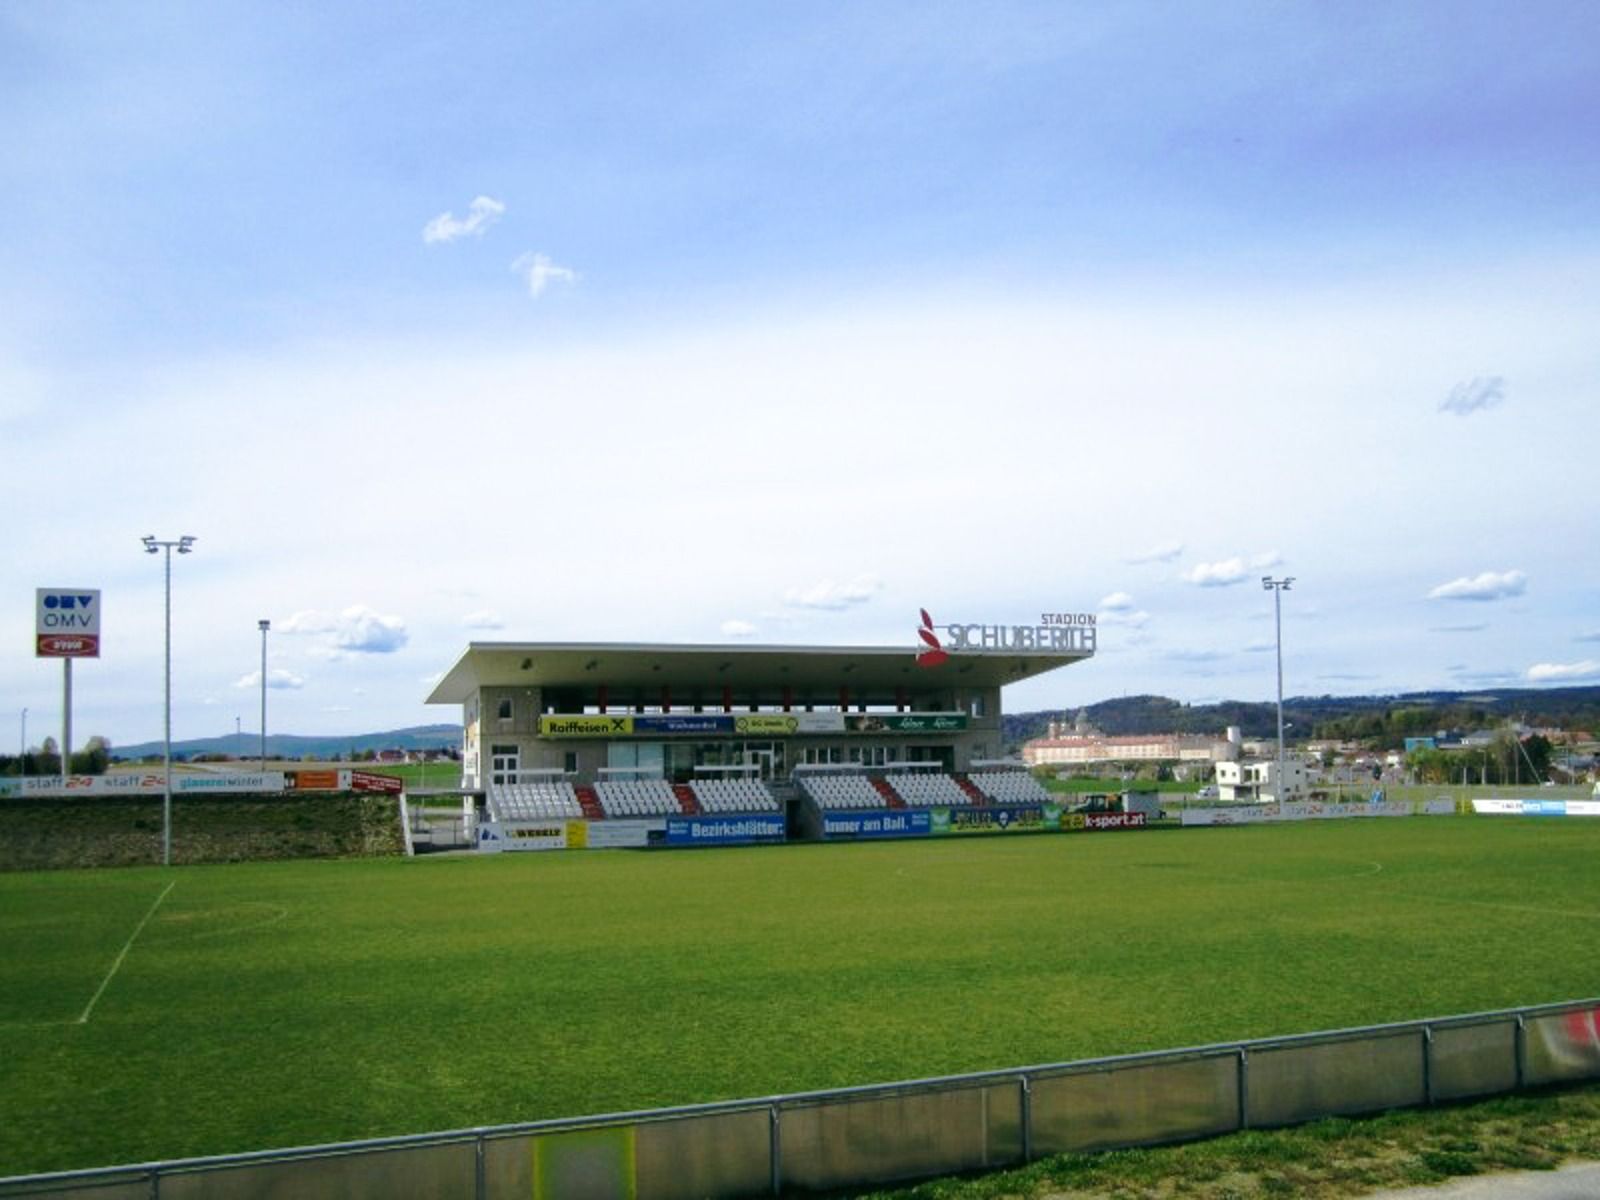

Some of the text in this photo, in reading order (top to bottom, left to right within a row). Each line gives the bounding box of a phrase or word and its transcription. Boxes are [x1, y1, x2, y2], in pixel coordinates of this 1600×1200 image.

[43, 613, 92, 627] OMV
[1041, 613, 1097, 625] STADION
[947, 624, 1097, 650] SCHUBERTH
[549, 720, 609, 733] Raiffeisen
[27, 777, 63, 790] staff
[824, 818, 861, 833] Immer
[863, 819, 881, 831] am
[883, 816, 909, 831] Ball.
[1085, 813, 1144, 829] k-sport.at
